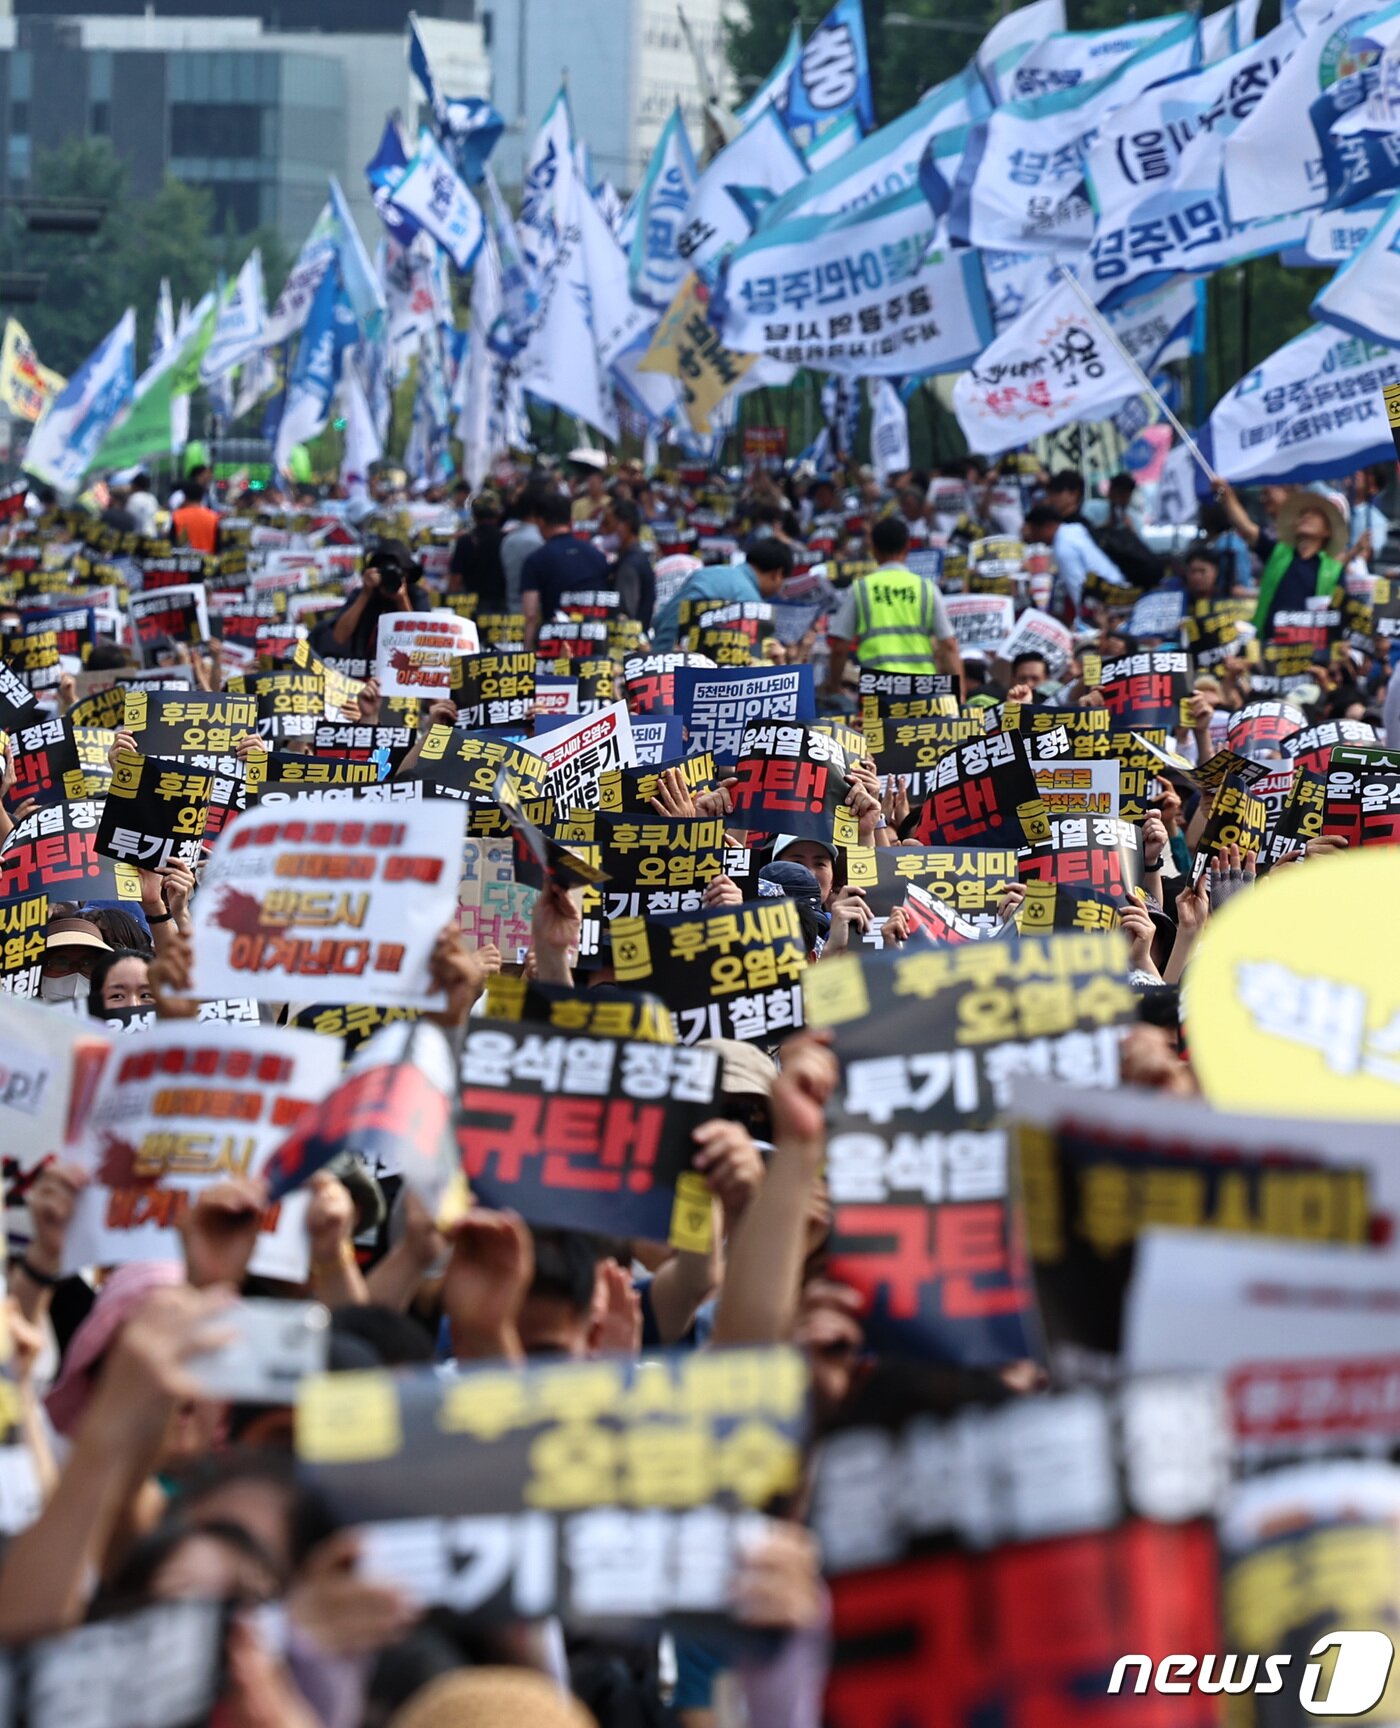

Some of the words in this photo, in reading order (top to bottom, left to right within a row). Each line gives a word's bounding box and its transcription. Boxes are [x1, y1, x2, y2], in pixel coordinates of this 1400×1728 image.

[625, 653, 684, 681] 윤석열
[1101, 653, 1150, 684] 윤석열
[1153, 652, 1188, 673] 정권
[480, 675, 535, 699] 오염수
[697, 680, 743, 699] 5천만이
[747, 676, 795, 696] 하나되어
[859, 674, 911, 695] 윤석열
[915, 675, 952, 694] 정권
[160, 702, 257, 727] 후쿠시마
[273, 694, 325, 714] 오염수
[21, 718, 66, 751] 정권
[315, 726, 372, 748] 윤석열
[376, 727, 411, 748] 정권
[582, 720, 612, 747] 오염수
[739, 726, 804, 757] 윤석열
[1070, 734, 1110, 758] 염수
[961, 732, 1016, 775] 정권
[732, 759, 828, 814] 규탄!
[1032, 768, 1092, 788] 속도로
[108, 827, 174, 868] 투기
[610, 819, 724, 854] 후쿠시마
[1093, 818, 1138, 850] 정권
[636, 853, 721, 886] 오염수
[894, 851, 1018, 880] 후쿠시마
[258, 889, 370, 929] 반드시
[669, 902, 802, 960] 후쿠시마
[0, 931, 46, 970] 염수
[894, 933, 1127, 998] 후쿠시마
[711, 948, 807, 997] 오염수
[957, 980, 1142, 1046] 오염수
[461, 1030, 617, 1097] 윤석열
[620, 1040, 718, 1104] 정권
[845, 1048, 980, 1122] 투기
[457, 1087, 666, 1195] 규탄!
[826, 1131, 1008, 1202] 윤석열
